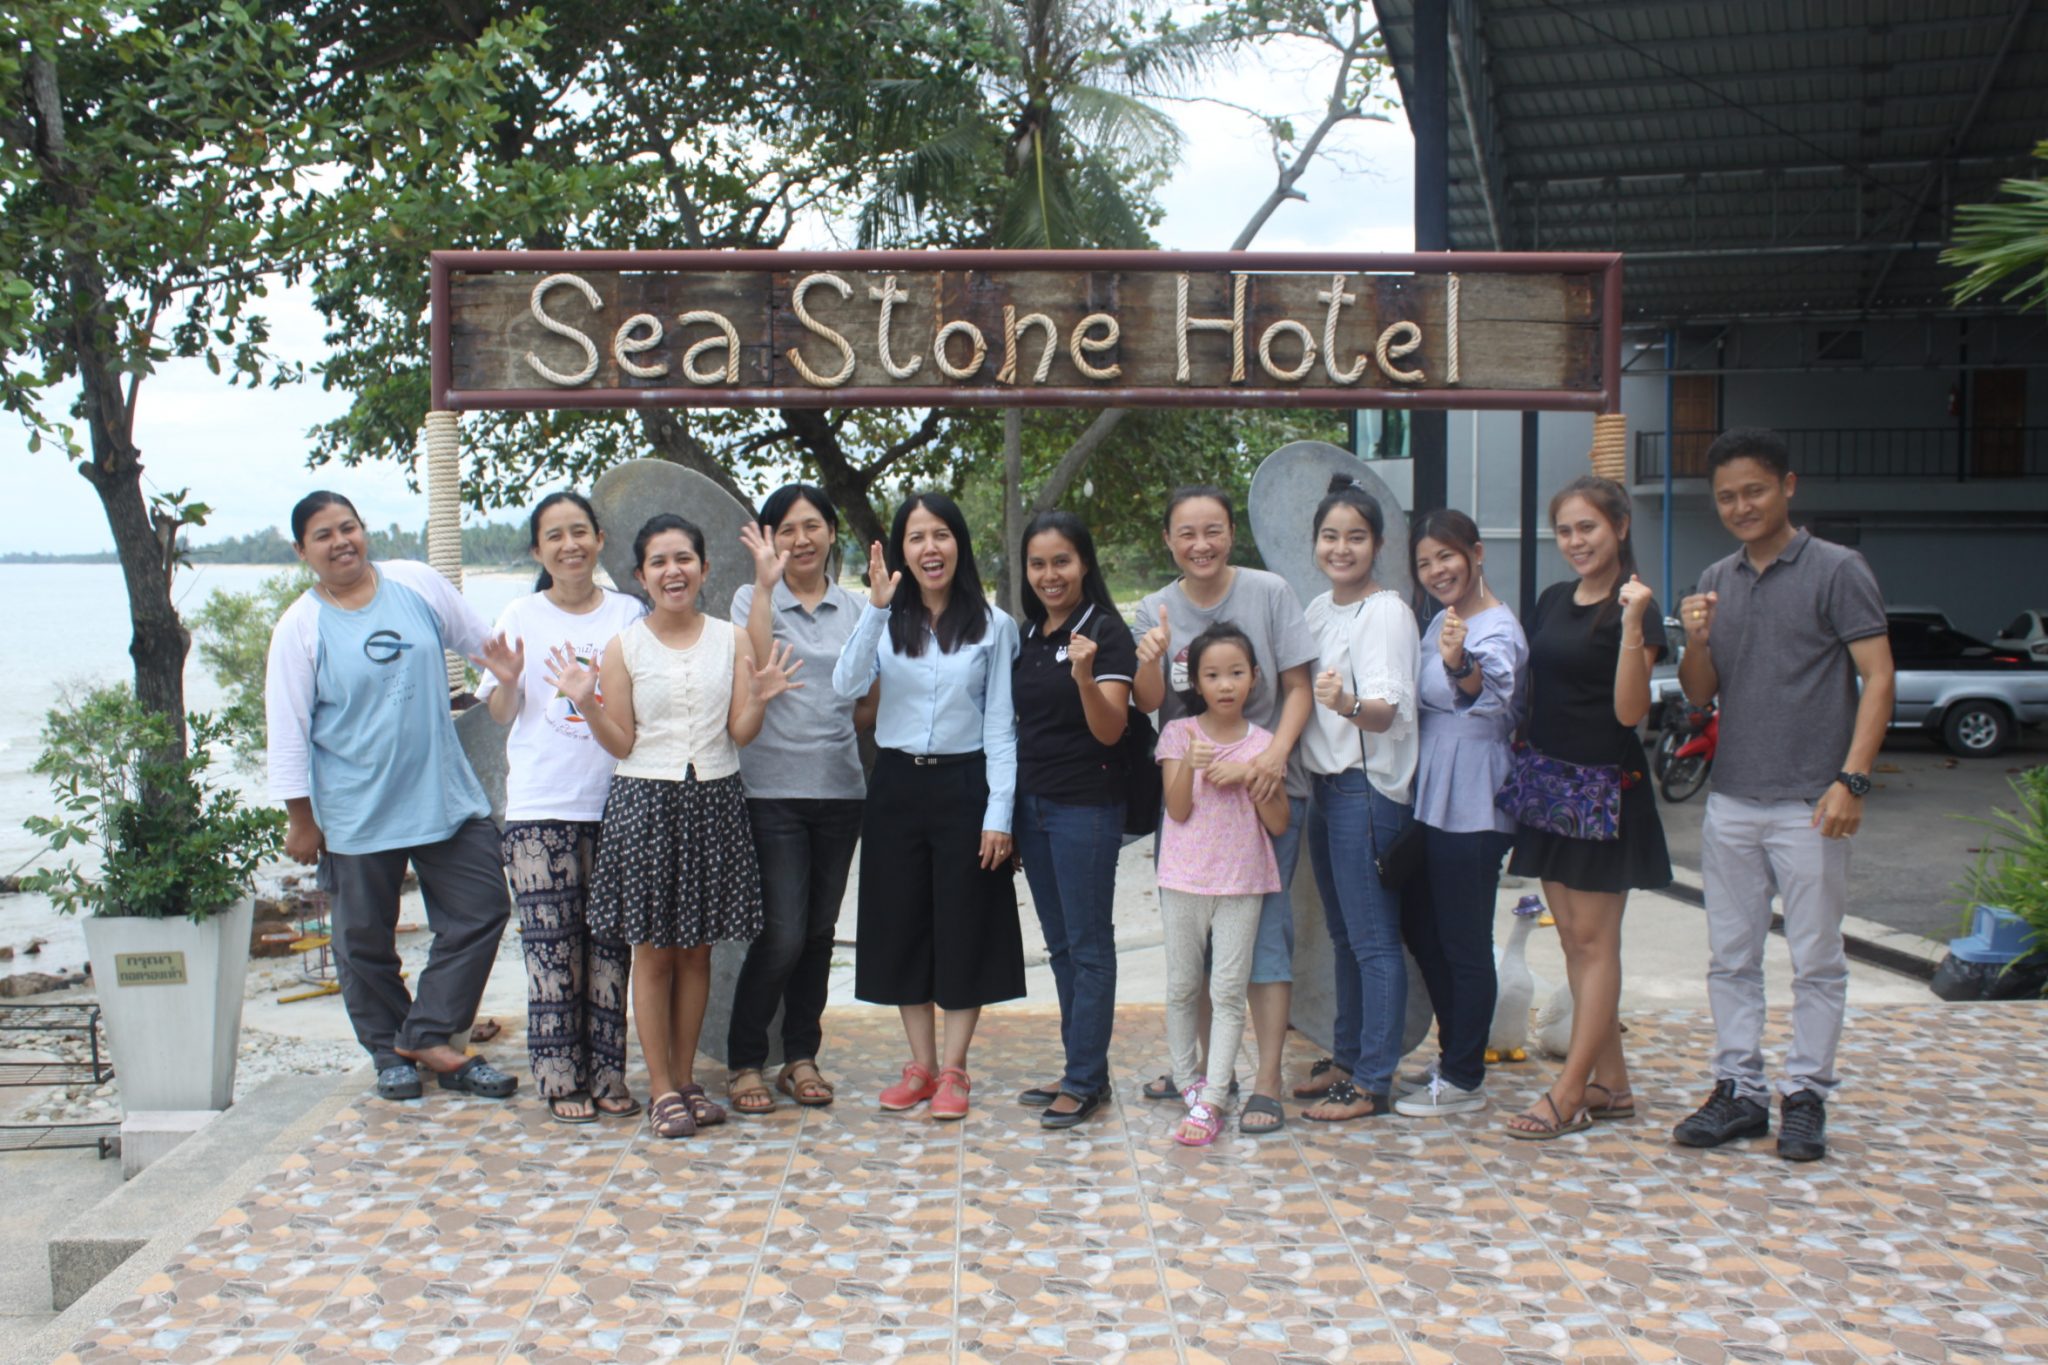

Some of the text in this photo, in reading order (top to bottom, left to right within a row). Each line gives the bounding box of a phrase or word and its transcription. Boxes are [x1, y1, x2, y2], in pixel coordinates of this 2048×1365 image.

[524, 273, 1459, 387] Sea Stone Hotel
